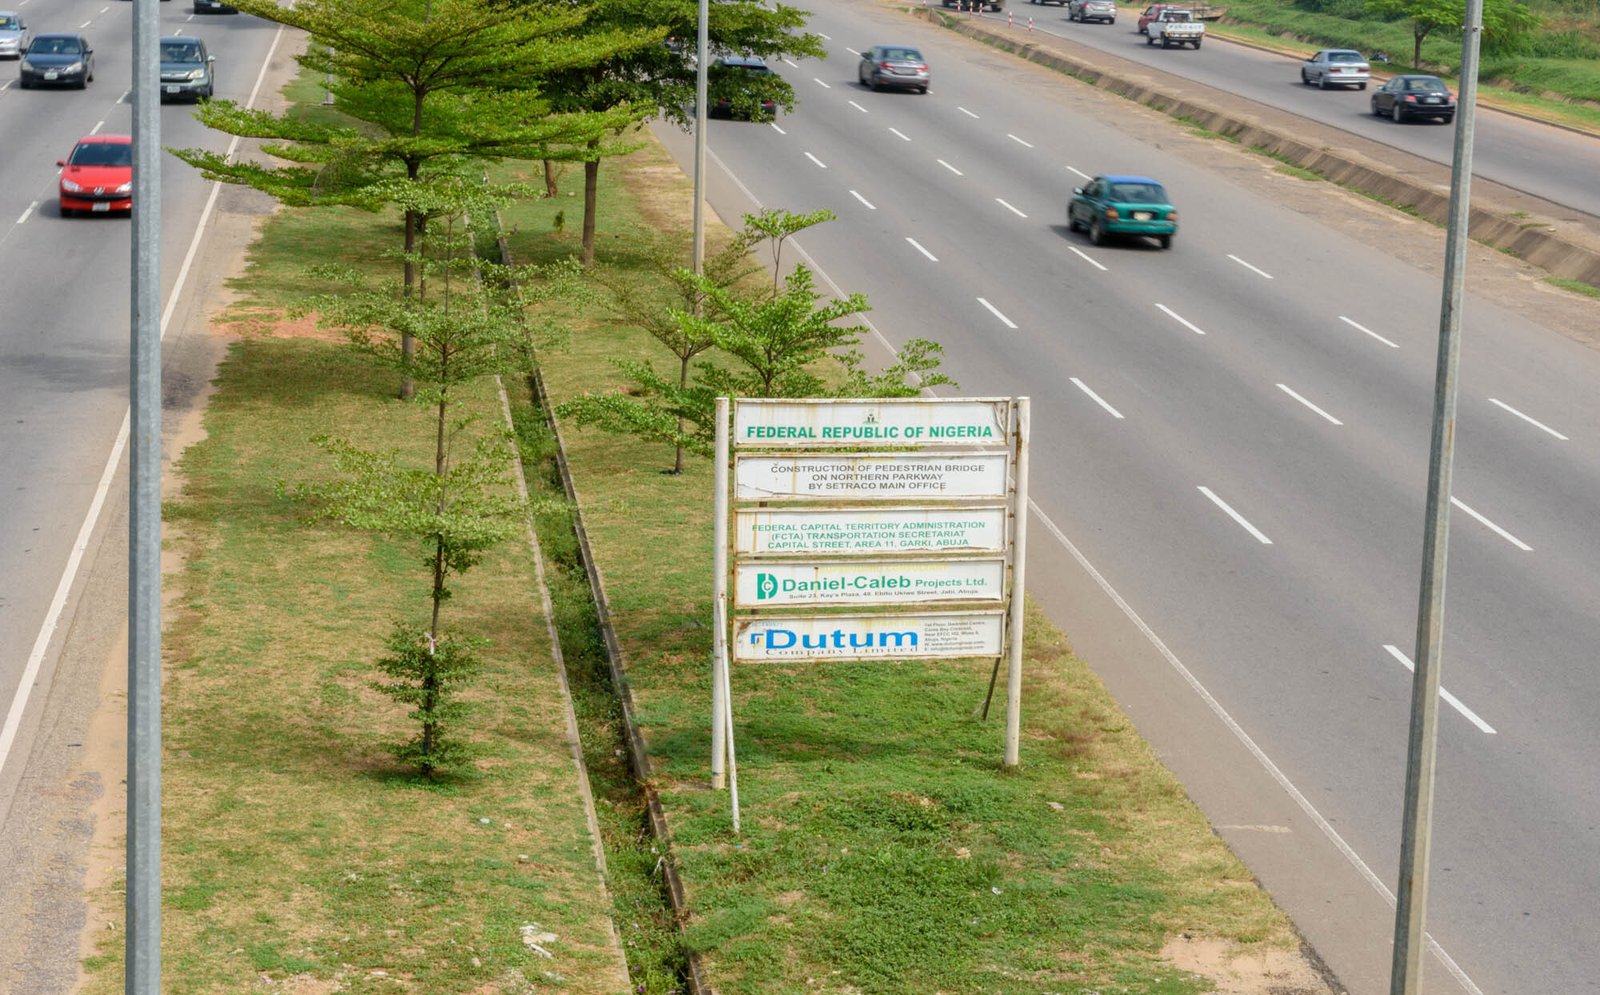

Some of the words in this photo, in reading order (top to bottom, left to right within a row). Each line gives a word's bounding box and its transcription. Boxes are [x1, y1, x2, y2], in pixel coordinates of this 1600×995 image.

[747, 426, 816, 438] FEDERAL
[822, 426, 898, 438] REPUBLIC
[904, 426, 924, 438] OF
[929, 426, 992, 438] NIGERIA
[772, 533, 804, 541] (FCTA)
[783, 576, 911, 592] Daniel-Caleb
[915, 578, 962, 588] Projects
[966, 578, 988, 586] Ltd.
[766, 629, 918, 649] Dutum
[766, 647, 845, 656] Company
[852, 644, 918, 655] Limited
